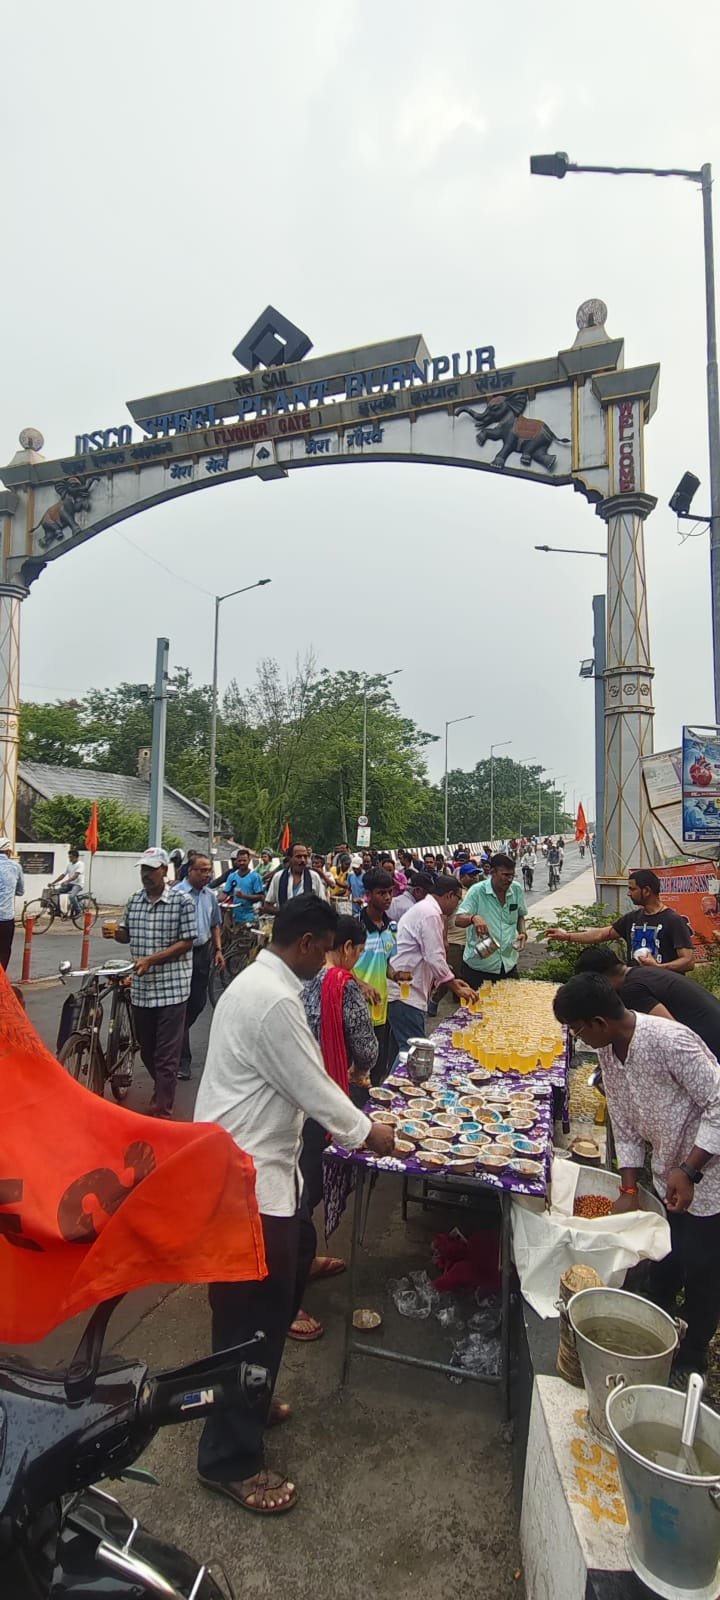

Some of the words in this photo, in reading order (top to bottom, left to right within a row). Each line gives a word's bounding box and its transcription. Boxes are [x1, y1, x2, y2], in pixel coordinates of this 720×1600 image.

[143, 405, 221, 440] STEEL
[239, 381, 329, 421] PLANT
[344, 345, 496, 400] BURNPUR
[261, 370, 293, 390] SAIL
[213, 421, 268, 445] FLYOVER
[278, 413, 311, 433] GATE
[618, 400, 636, 494] WELCOME
